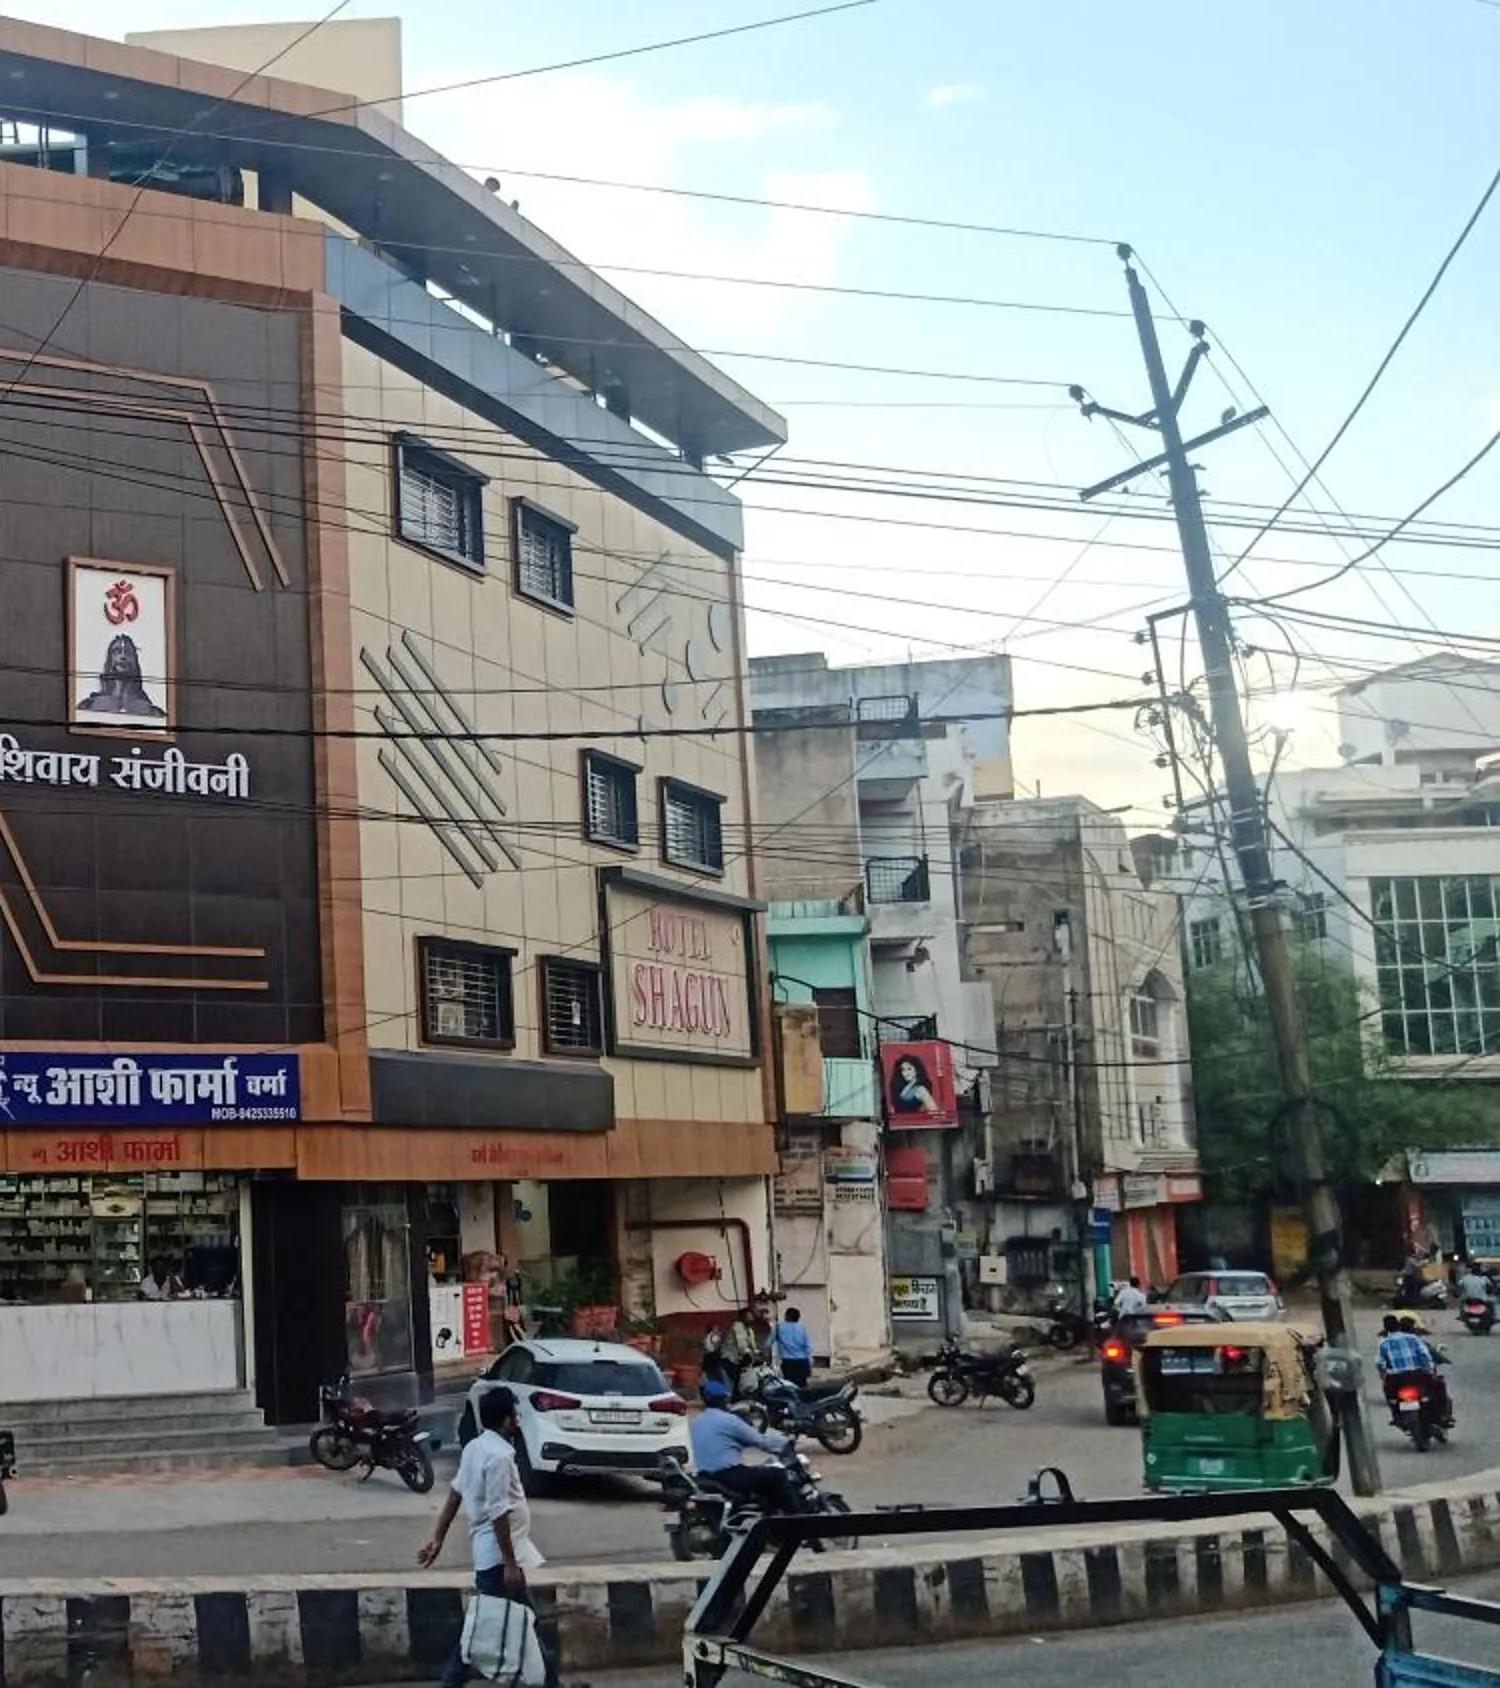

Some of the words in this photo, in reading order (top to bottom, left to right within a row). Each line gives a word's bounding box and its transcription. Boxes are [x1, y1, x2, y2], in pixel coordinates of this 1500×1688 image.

[109, 747, 249, 798] संजीवनी
[633, 963, 731, 1038] SHAGUN
[12, 1073, 43, 1105] न्यू
[46, 1058, 143, 1105] आशी
[148, 1056, 238, 1105] फार्मा
[246, 1069, 288, 1097] वर्मा
[56, 1132, 114, 1162] आशी
[124, 1134, 181, 1162] फार्मा
